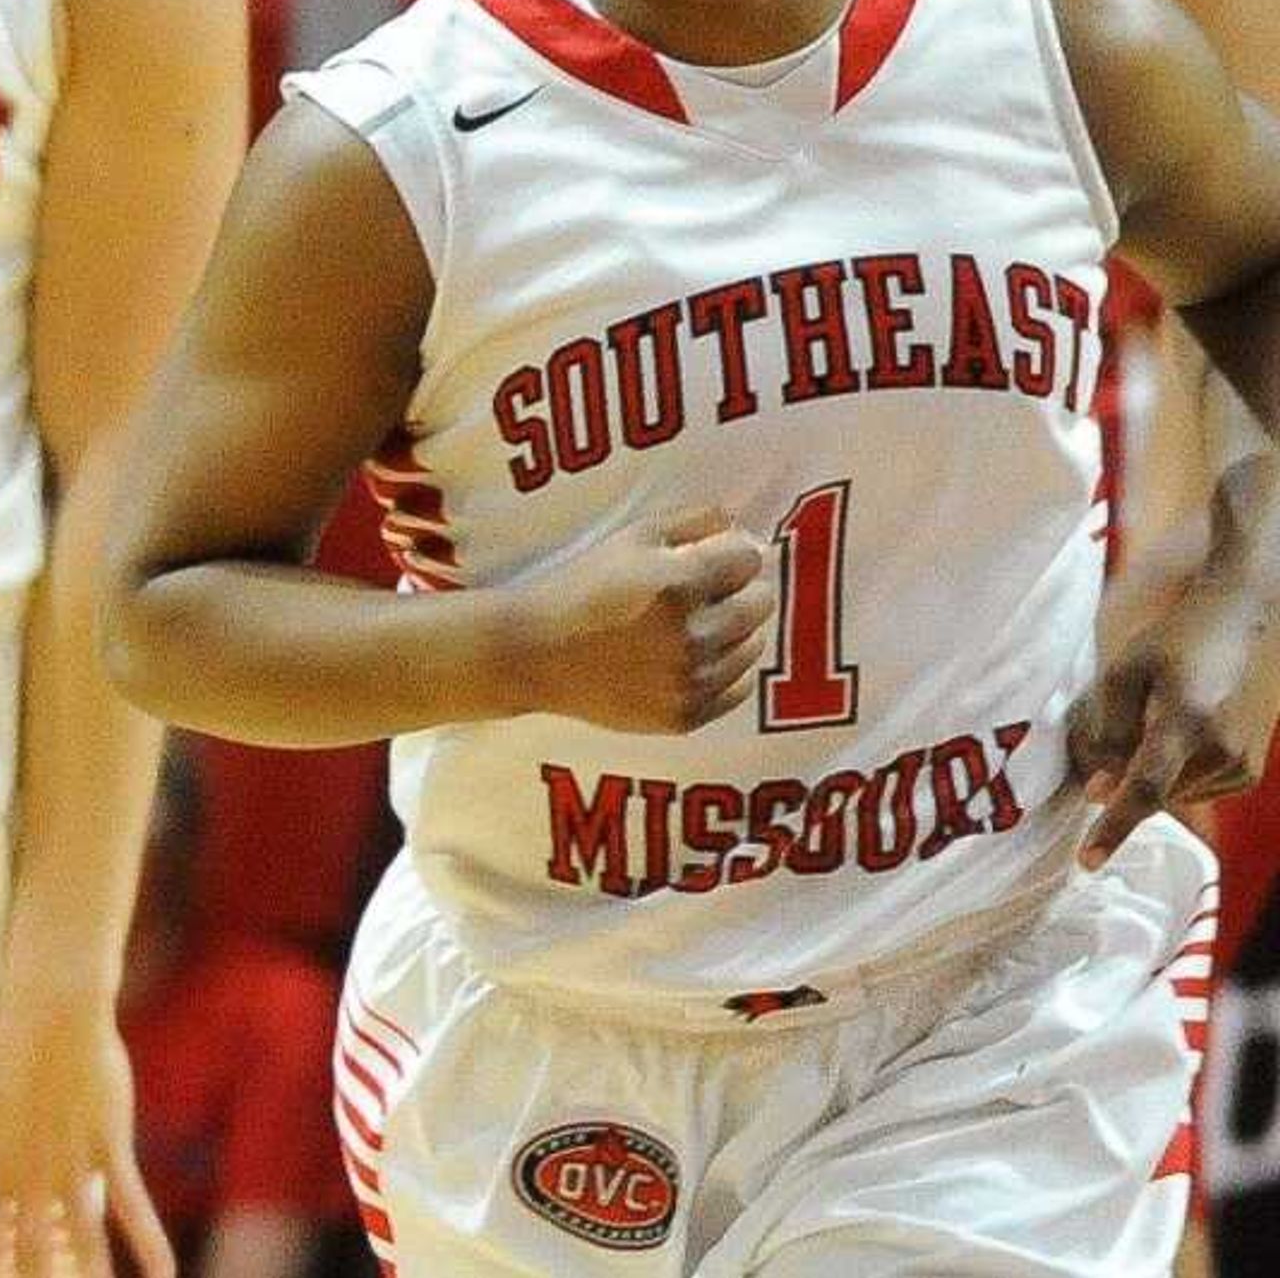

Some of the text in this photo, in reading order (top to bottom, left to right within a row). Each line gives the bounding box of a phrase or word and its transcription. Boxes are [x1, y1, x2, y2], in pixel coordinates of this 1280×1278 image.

[493, 253, 1091, 494] SOUTHEAST
[758, 479, 858, 733] 1
[559, 1162, 656, 1212] OVC
